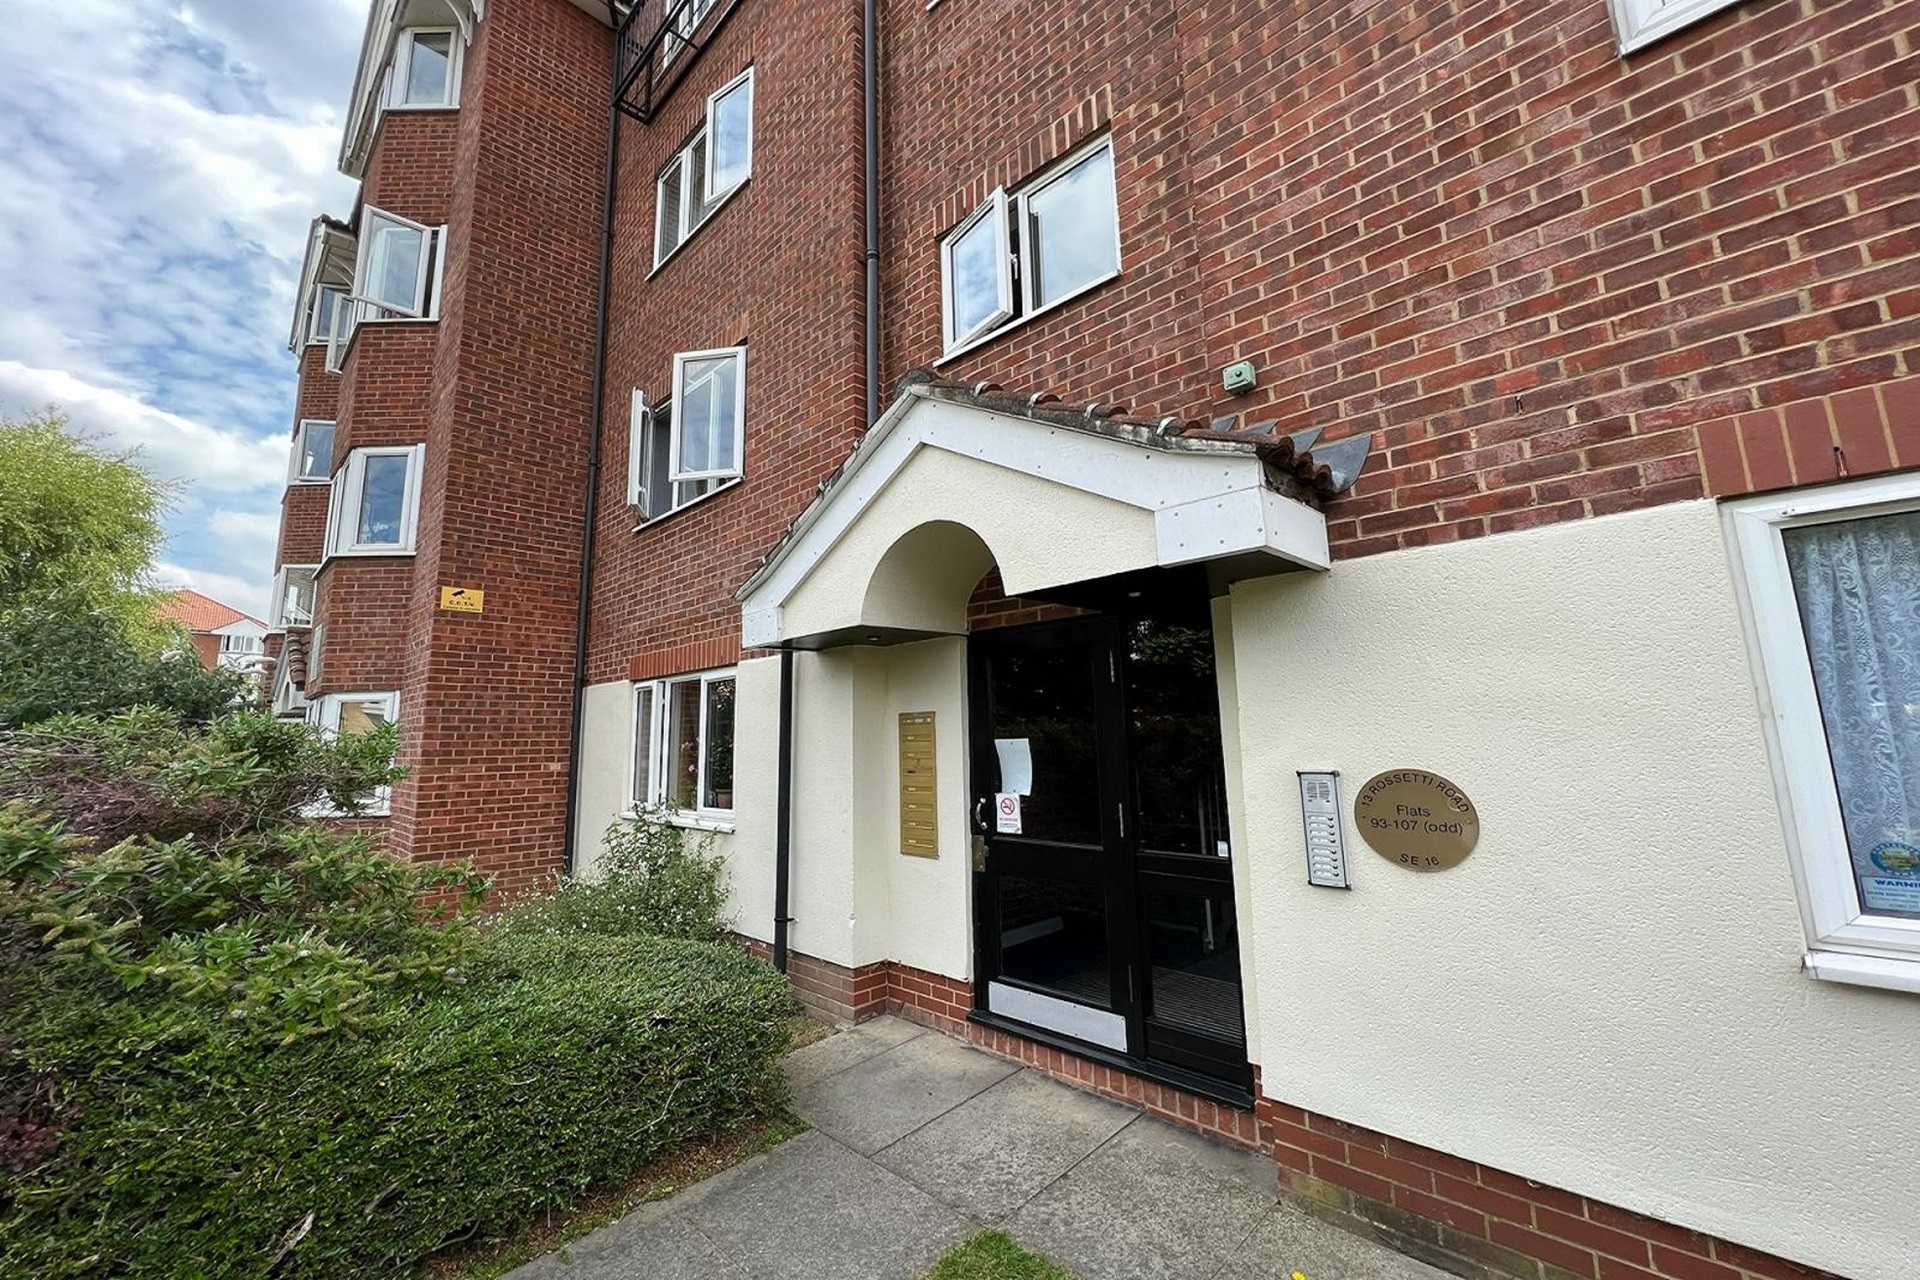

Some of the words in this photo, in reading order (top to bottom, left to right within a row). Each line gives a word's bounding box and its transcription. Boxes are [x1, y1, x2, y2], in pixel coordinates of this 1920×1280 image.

[1361, 794, 1373, 807] 13
[1369, 772, 1434, 796] ROSSETTI
[1436, 781, 1470, 813] ROAD
[1396, 804, 1431, 817] Flats
[1370, 817, 1418, 831] 93-107
[1424, 821, 1464, 837] (odd)
[1399, 853, 1419, 866] SE
[1425, 855, 1440, 866] 16
[1874, 879, 1920, 888] WARNI
